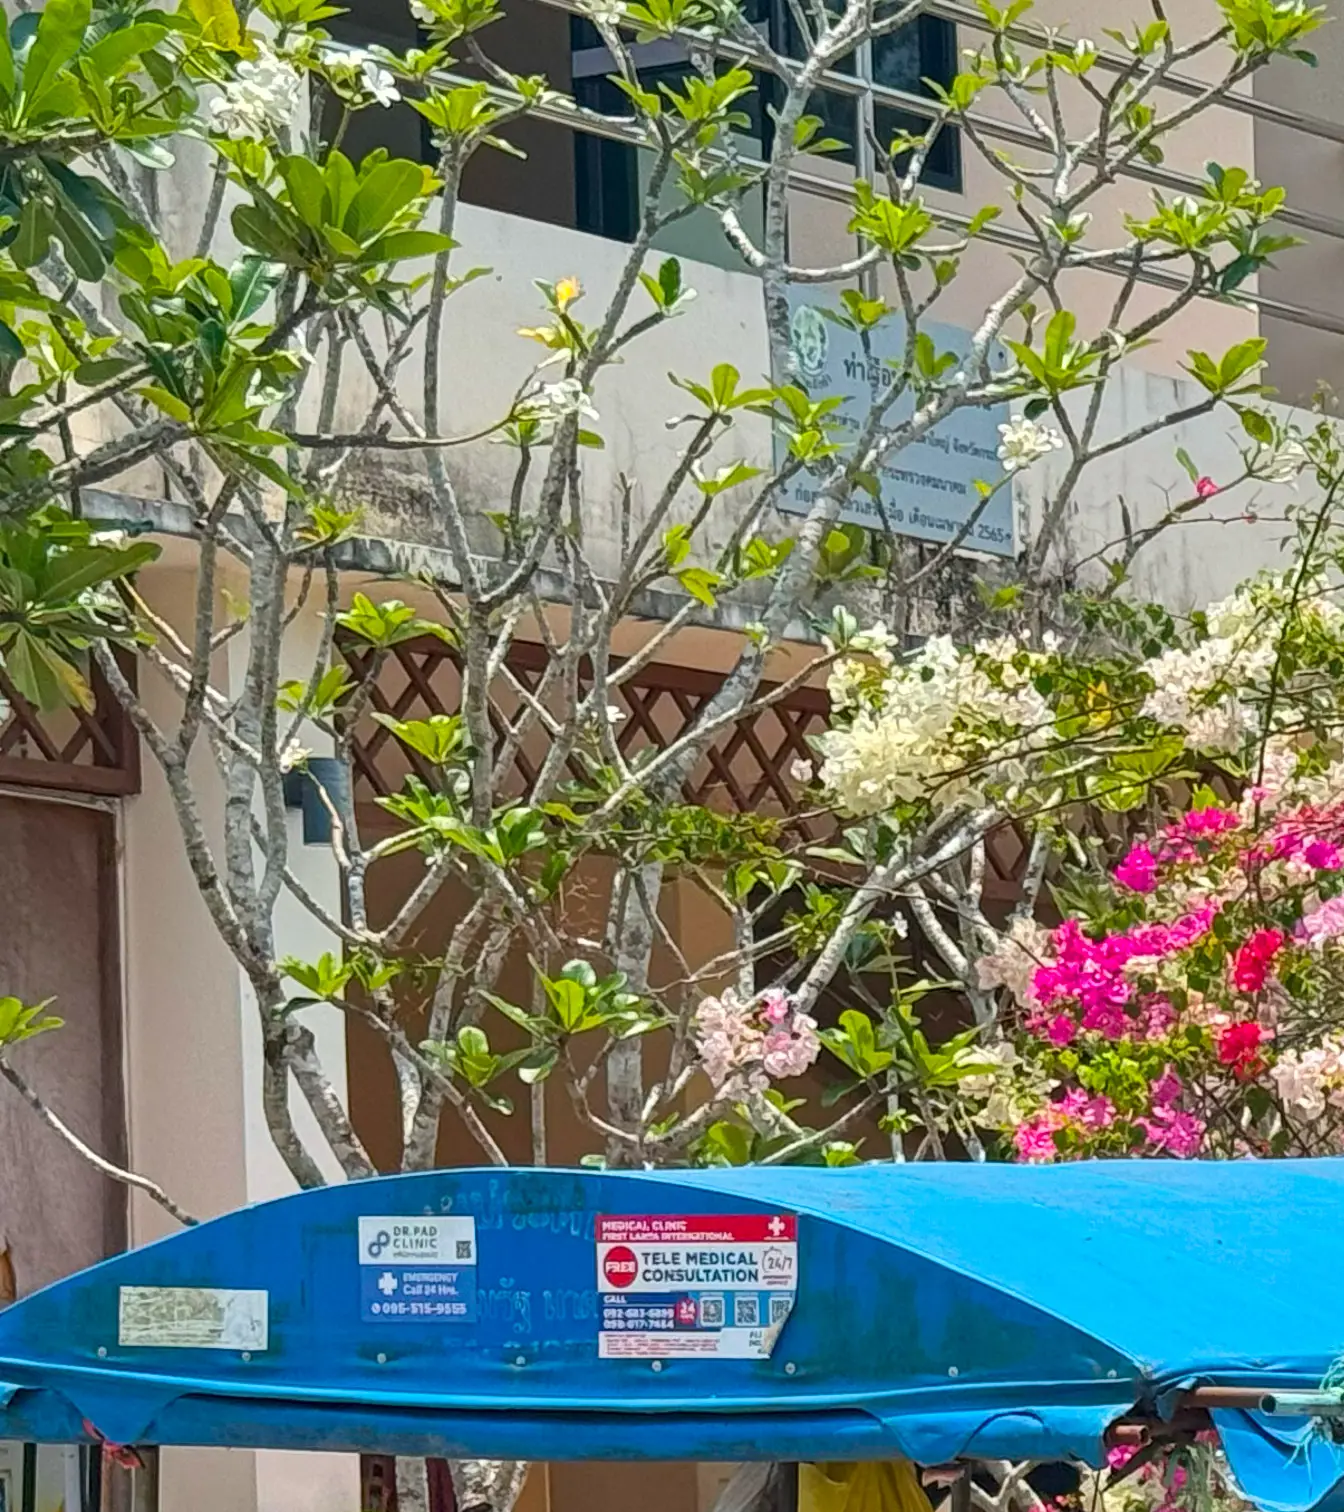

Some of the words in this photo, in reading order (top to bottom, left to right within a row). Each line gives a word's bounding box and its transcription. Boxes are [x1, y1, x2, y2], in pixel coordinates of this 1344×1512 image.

[977, 523, 1004, 544] 2565
[601, 1220, 650, 1231] MEDICAL
[651, 1220, 688, 1231] CLINIC
[393, 1238, 438, 1249] CLINIC
[641, 1252, 681, 1265] TELE
[685, 1252, 758, 1265] MEDICAL
[767, 1255, 793, 1271] 24/7
[605, 1261, 636, 1274] FREE
[641, 1269, 759, 1282] CONSULTATION
[403, 1284, 423, 1295] Call
[603, 1295, 627, 1304] CALL
